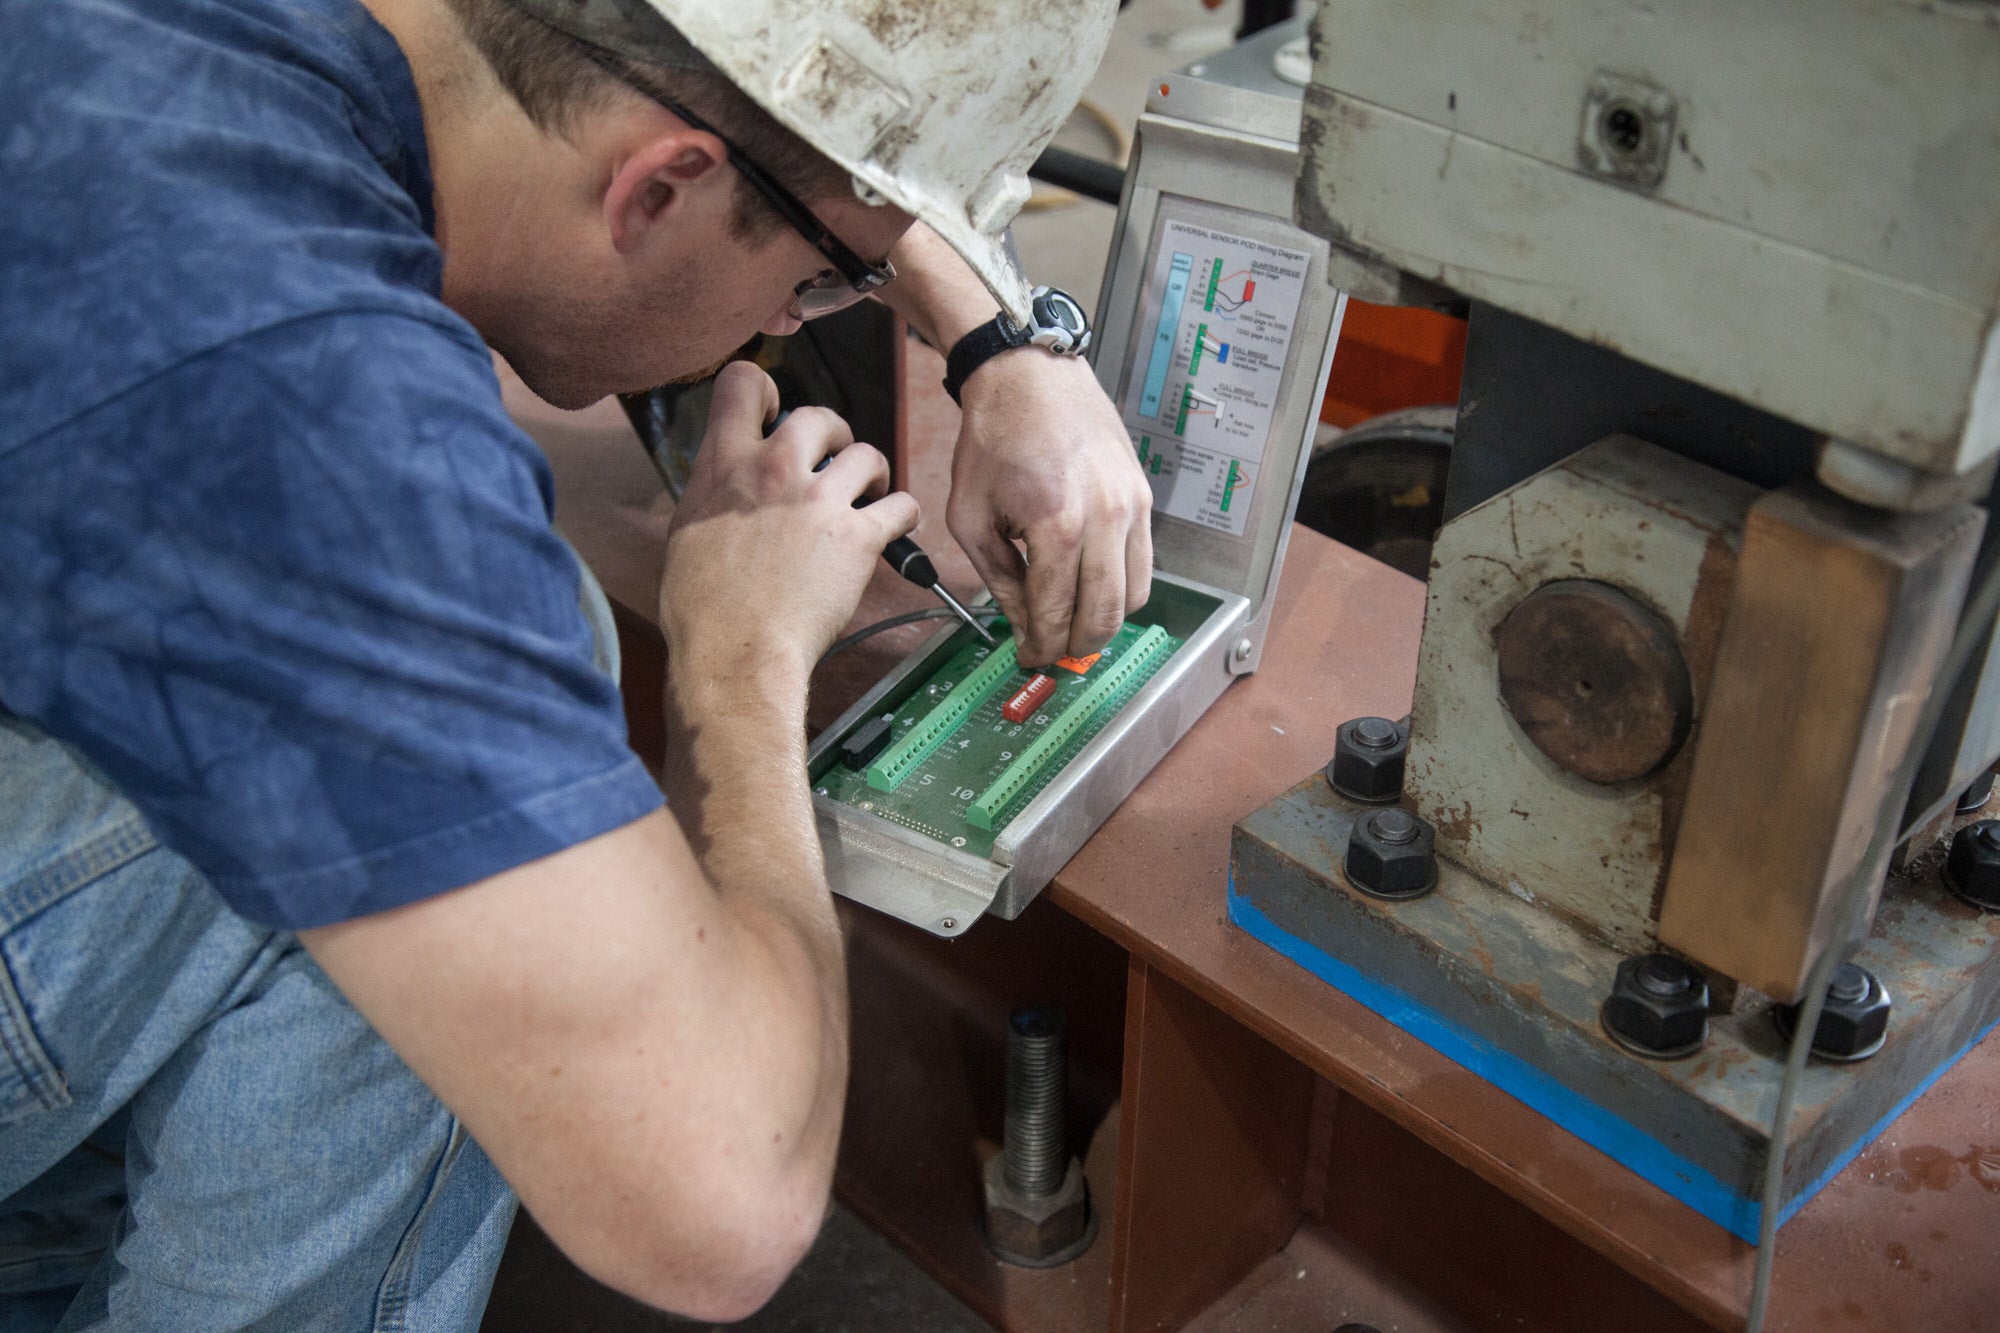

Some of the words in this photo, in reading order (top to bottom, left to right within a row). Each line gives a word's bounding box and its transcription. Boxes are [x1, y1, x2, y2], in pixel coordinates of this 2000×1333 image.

[1171, 224, 1209, 238] UNIVERSAL
[1211, 234, 1238, 245] SENSOR
[1240, 241, 1256, 249] POD
[1256, 245, 1277, 256] Wiring
[1278, 250, 1305, 262] Diagram
[974, 647, 990, 658] 2
[1100, 647, 1113, 657] 6
[1070, 675, 1087, 685] 7
[939, 681, 954, 692] 3
[902, 716, 915, 727] 4
[1034, 714, 1049, 725] 8
[958, 739, 971, 750] 4
[999, 751, 1013, 761] 9
[920, 774, 936, 786] 5
[949, 786, 975, 800] 10
